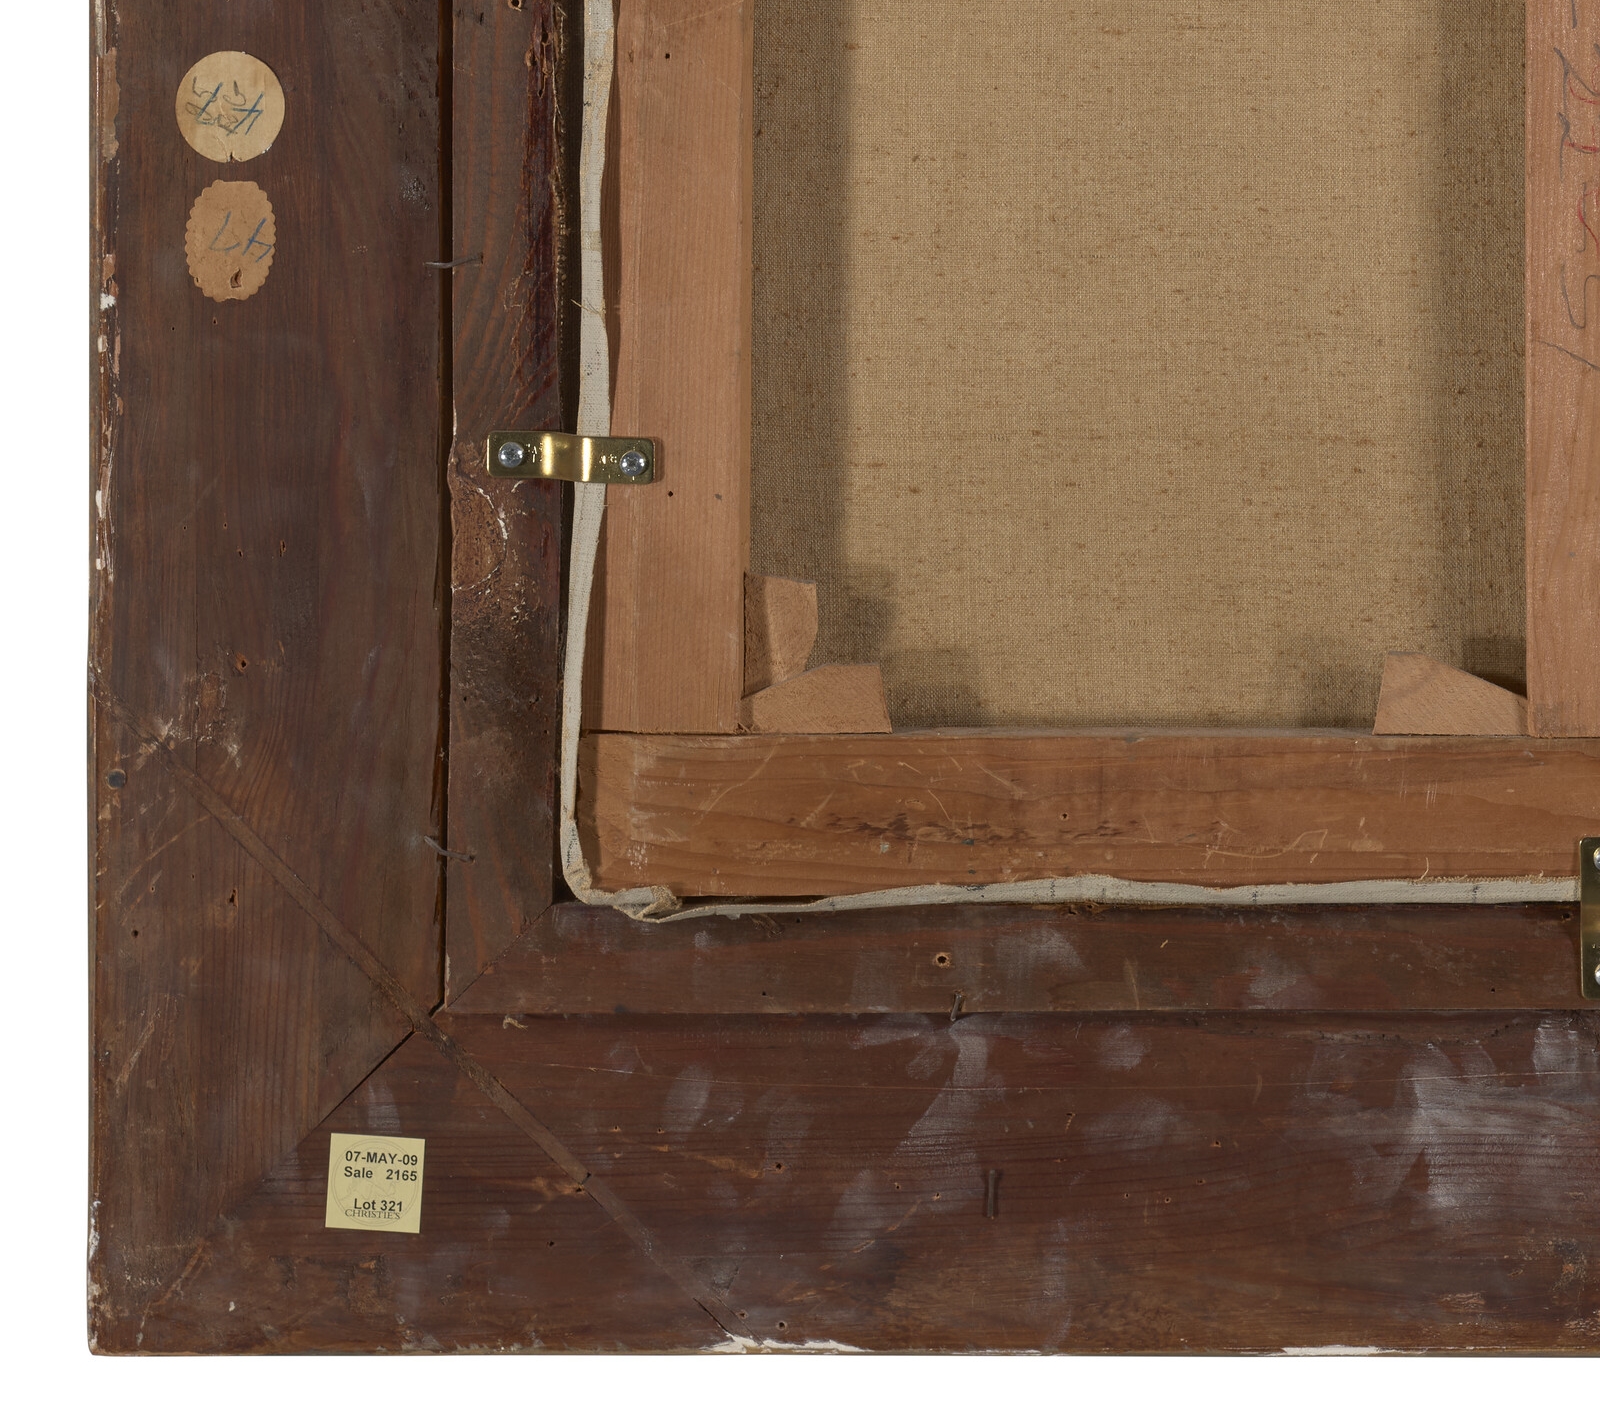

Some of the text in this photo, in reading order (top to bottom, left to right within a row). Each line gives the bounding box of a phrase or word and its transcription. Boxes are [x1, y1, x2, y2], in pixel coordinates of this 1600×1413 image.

[345, 1150, 418, 1166] 07-MAY-09
[344, 1166, 417, 1182] Sale 2165
[353, 1198, 403, 1212] Lot 321
[344, 1208, 401, 1220] CHRISTIE'S
